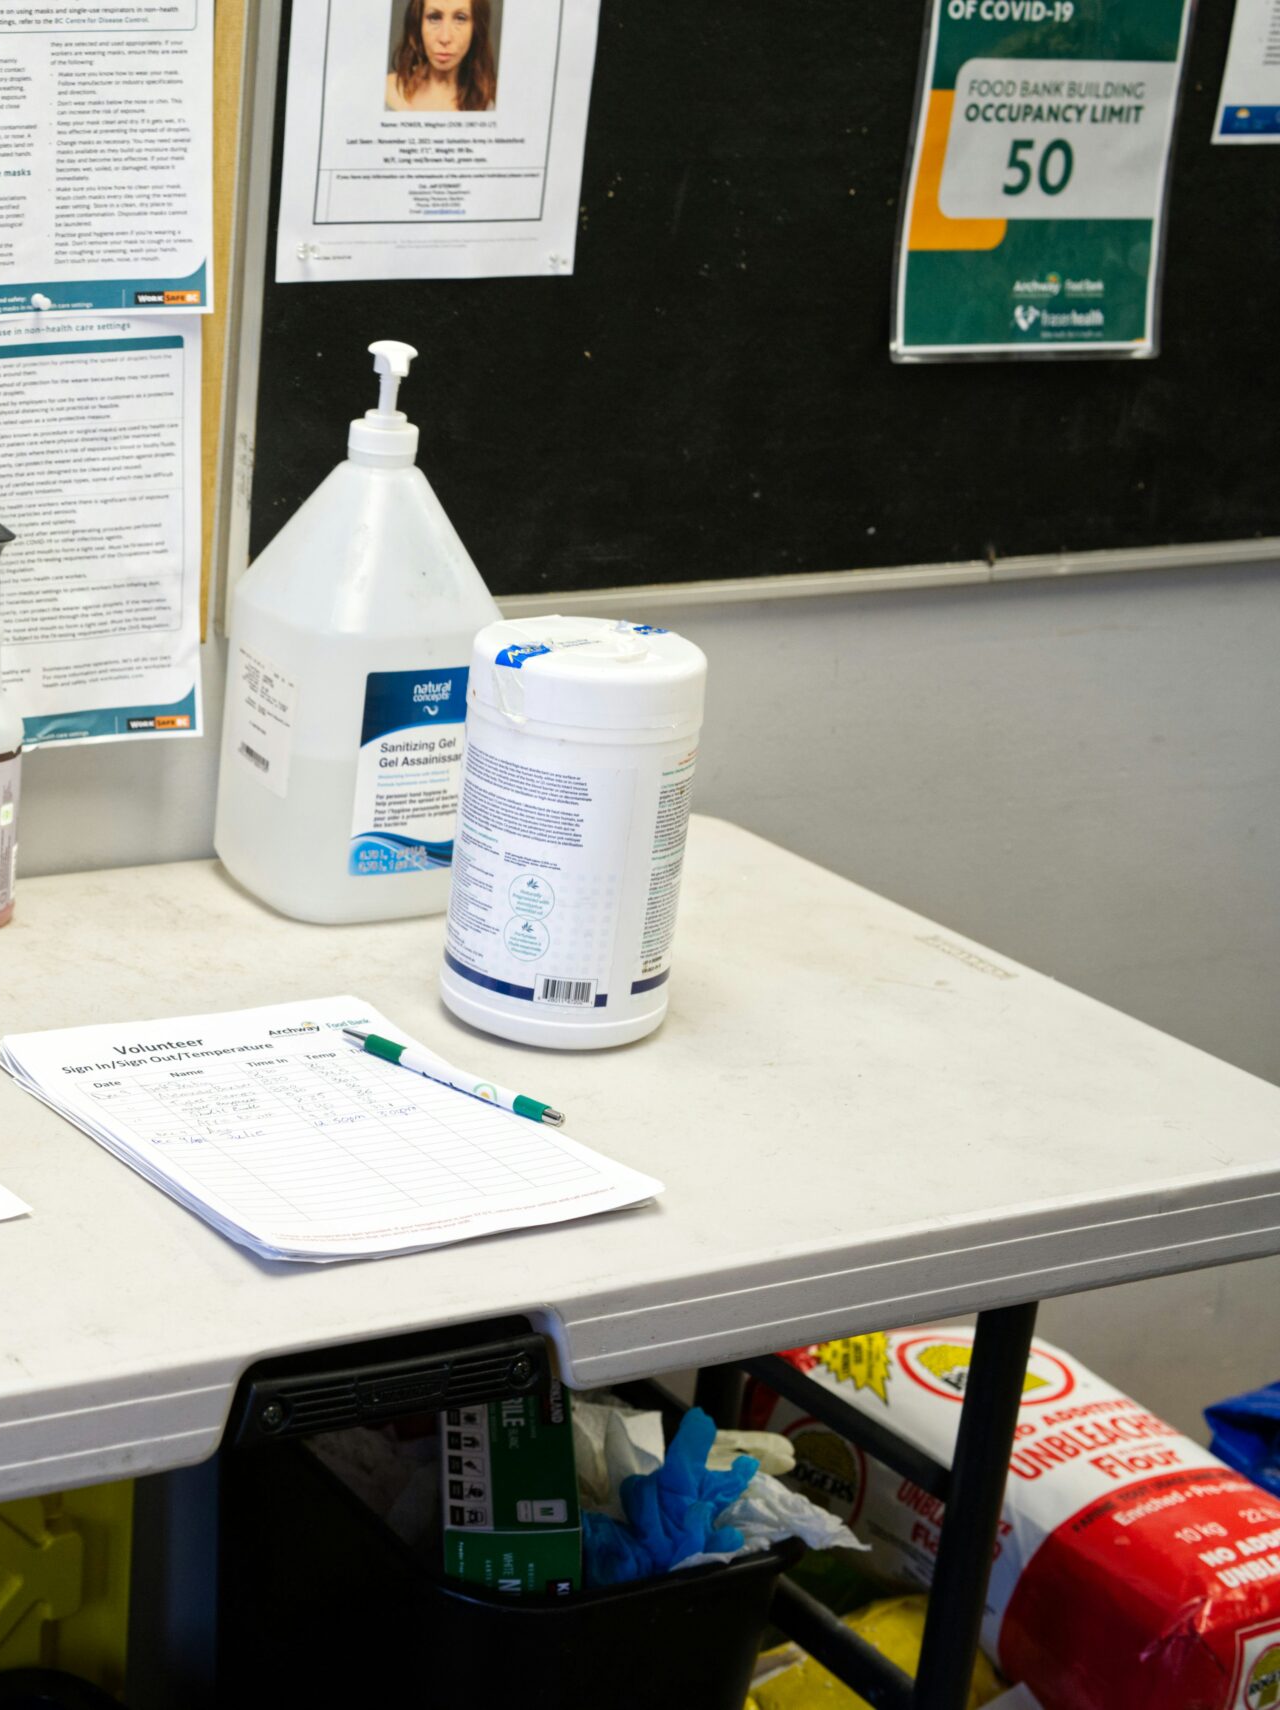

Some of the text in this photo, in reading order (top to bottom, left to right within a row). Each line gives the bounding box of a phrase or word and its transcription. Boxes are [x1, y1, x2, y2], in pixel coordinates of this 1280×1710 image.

[948, 0, 1074, 23] OF COVID-19
[969, 79, 1145, 101] FOOD BANK BUILDING
[965, 103, 1144, 125] OCCUPANCY LIMIT
[3, 168, 32, 177] masks
[1002, 138, 1074, 196] 50
[14, 327, 22, 335] in
[24, 324, 73, 334] non-health
[75, 324, 94, 332] care
[97, 321, 131, 331] settings
[413, 680, 452, 694] natural
[412, 693, 451, 702] concepts
[380, 737, 457, 753] Sanitizing Gel
[379, 757, 398, 768] Gel
[268, 1025, 320, 1037] Archway
[113, 1037, 204, 1056] Volunteer
[62, 1043, 274, 1075] Sign In/Sign Out/Temperature
[93, 1052, 337, 1089] Date Name Time In Temp
[501, 1397, 525, 1428] RILE
[1089, 1450, 1183, 1479] Flour
[1175, 1527, 1201, 1544] 10
[1198, 1546, 1237, 1568] NO
